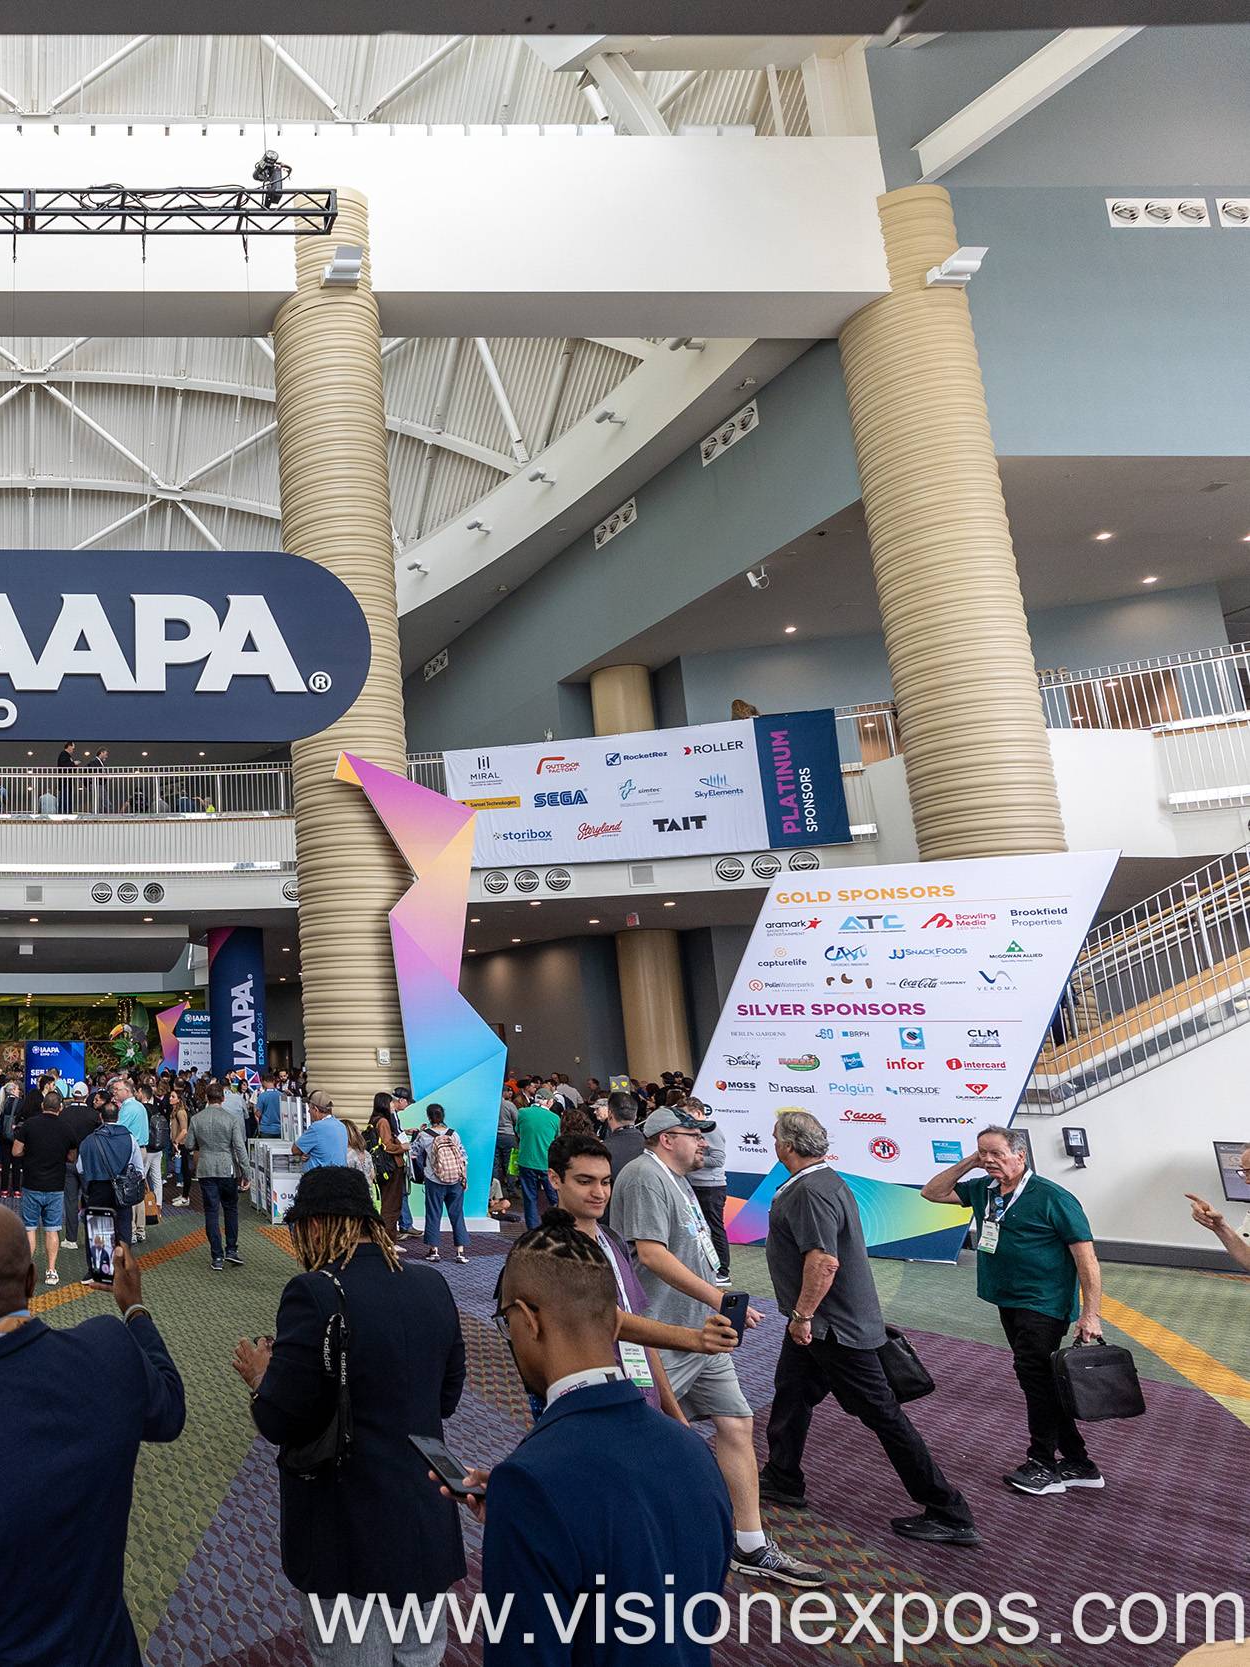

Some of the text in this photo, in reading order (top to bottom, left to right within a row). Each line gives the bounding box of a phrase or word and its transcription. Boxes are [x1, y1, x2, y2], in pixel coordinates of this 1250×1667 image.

[694, 740, 744, 754] ROLLER
[623, 751, 668, 761] RocketRez
[470, 772, 500, 780] MIRAL
[770, 729, 801, 835] PLATINUM
[533, 789, 588, 808] SEGA
[798, 767, 818, 833] SPONSORS
[653, 815, 707, 833] TAIT
[503, 829, 552, 841] storibox
[776, 884, 956, 904] GOLD SPONSORS
[955, 912, 996, 921] Bowling
[1010, 907, 1068, 916] Brookfield
[765, 919, 806, 929] aramark
[839, 914, 905, 930] ATC
[1011, 918, 1062, 927] Properties
[757, 958, 808, 969] capturelife
[737, 1003, 926, 1016] SILVER SPONSORS
[231, 980, 257, 1065] IAAPA
[967, 1029, 999, 1038] CLM
[257, 1038, 265, 1065] EXPO
[886, 1057, 925, 1070] infor
[964, 1061, 1007, 1069] intercard
[780, 1084, 816, 1094] nassal
[829, 1083, 874, 1096] Polgün
[899, 1086, 940, 1095] PROSLIDE
[839, 1110, 887, 1122] Sacoa
[919, 1116, 974, 1125] semnox
[738, 1145, 768, 1154] Triotech
